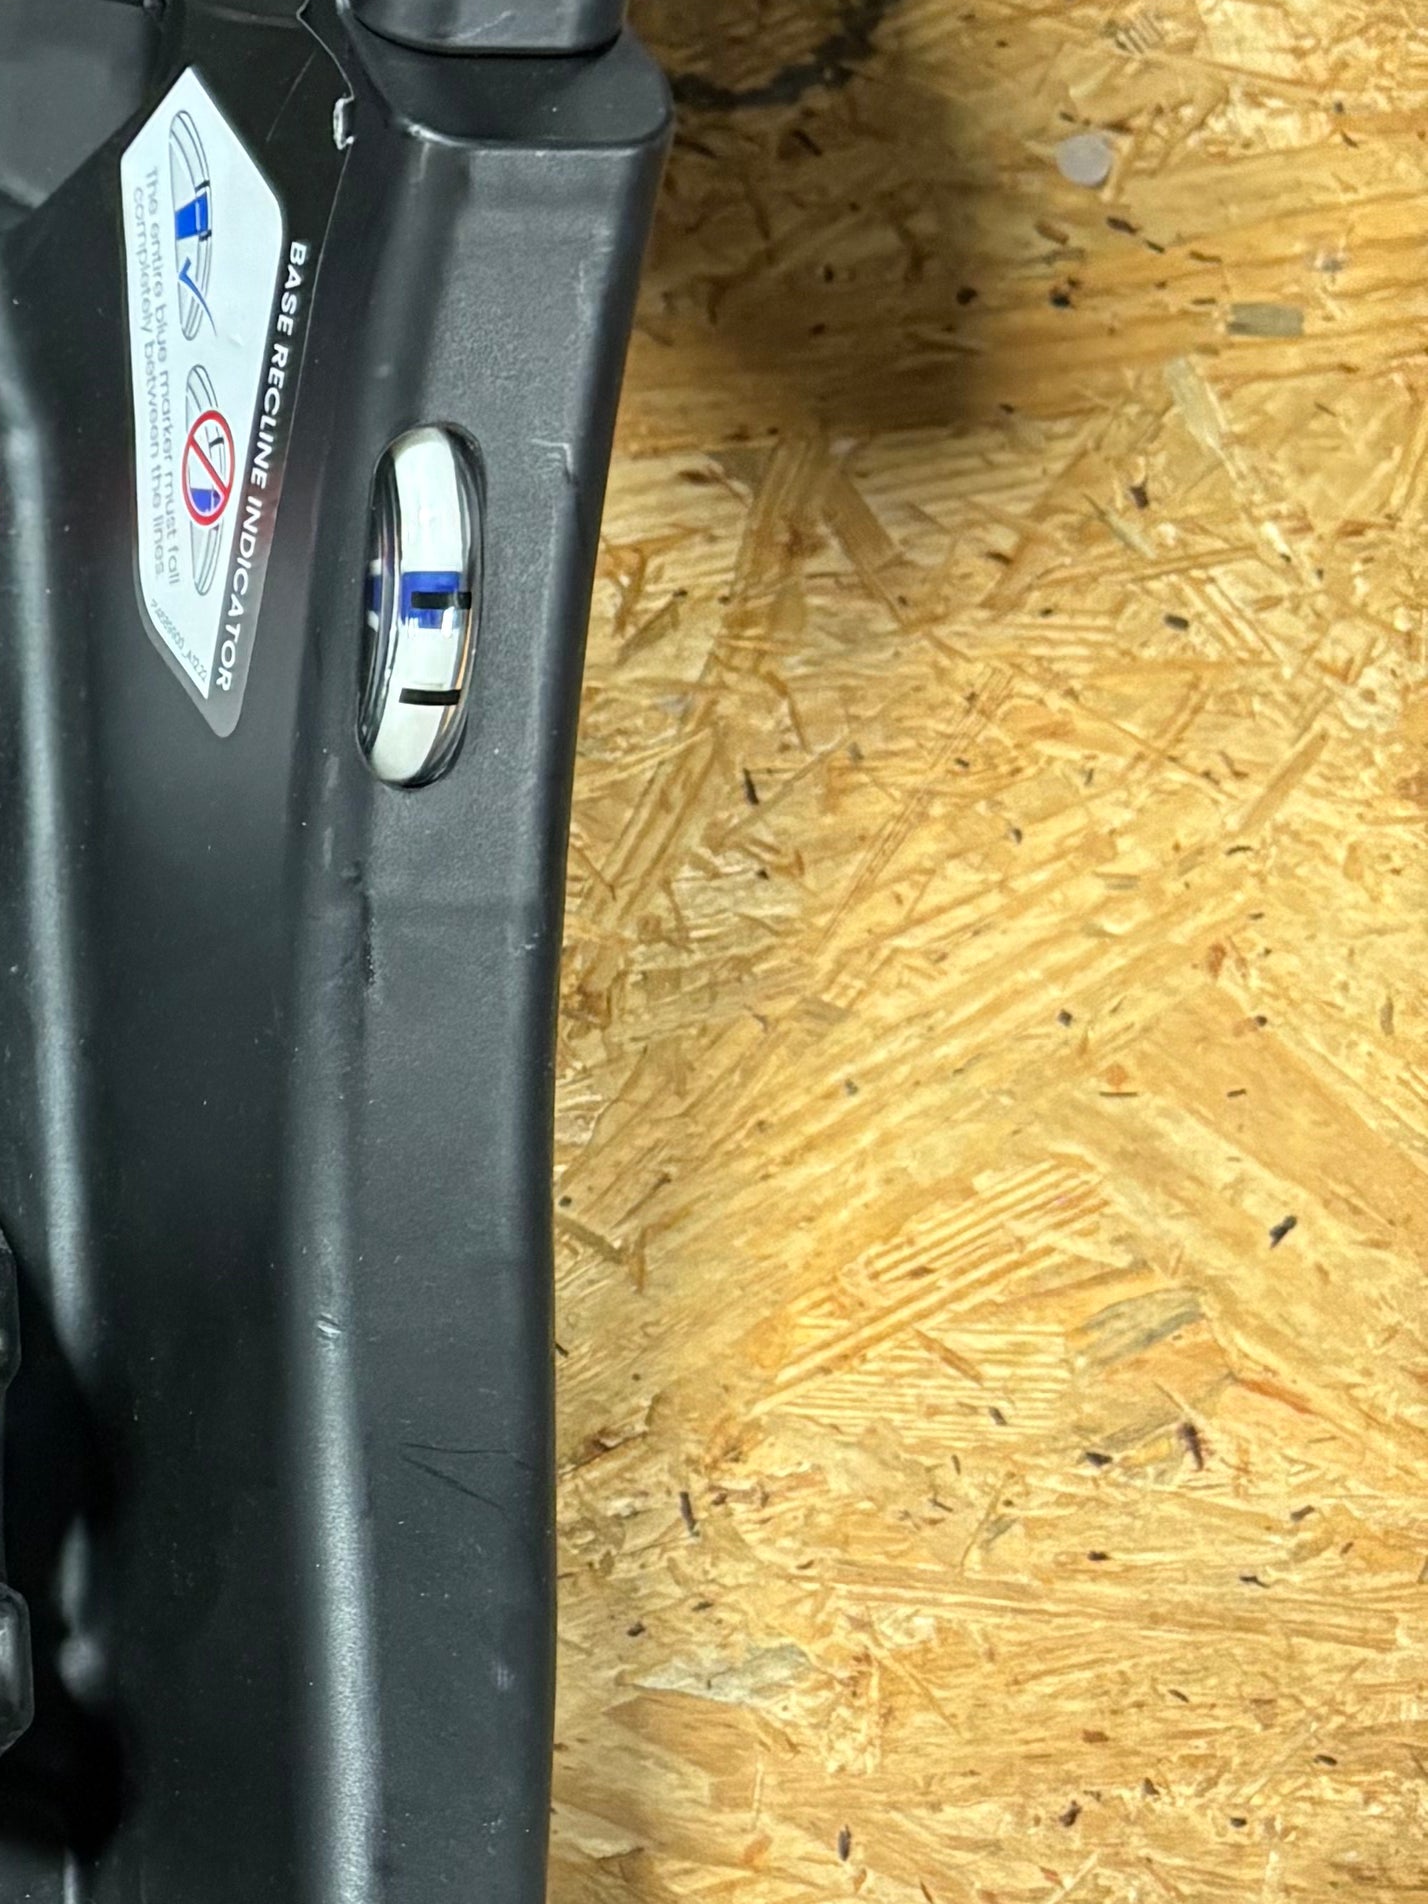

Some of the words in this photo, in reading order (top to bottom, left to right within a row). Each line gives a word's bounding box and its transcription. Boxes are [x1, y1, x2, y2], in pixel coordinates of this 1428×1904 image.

[276, 241, 307, 336] BASE
[250, 342, 290, 489] RECLINE
[216, 495, 263, 692] INDICATOR
